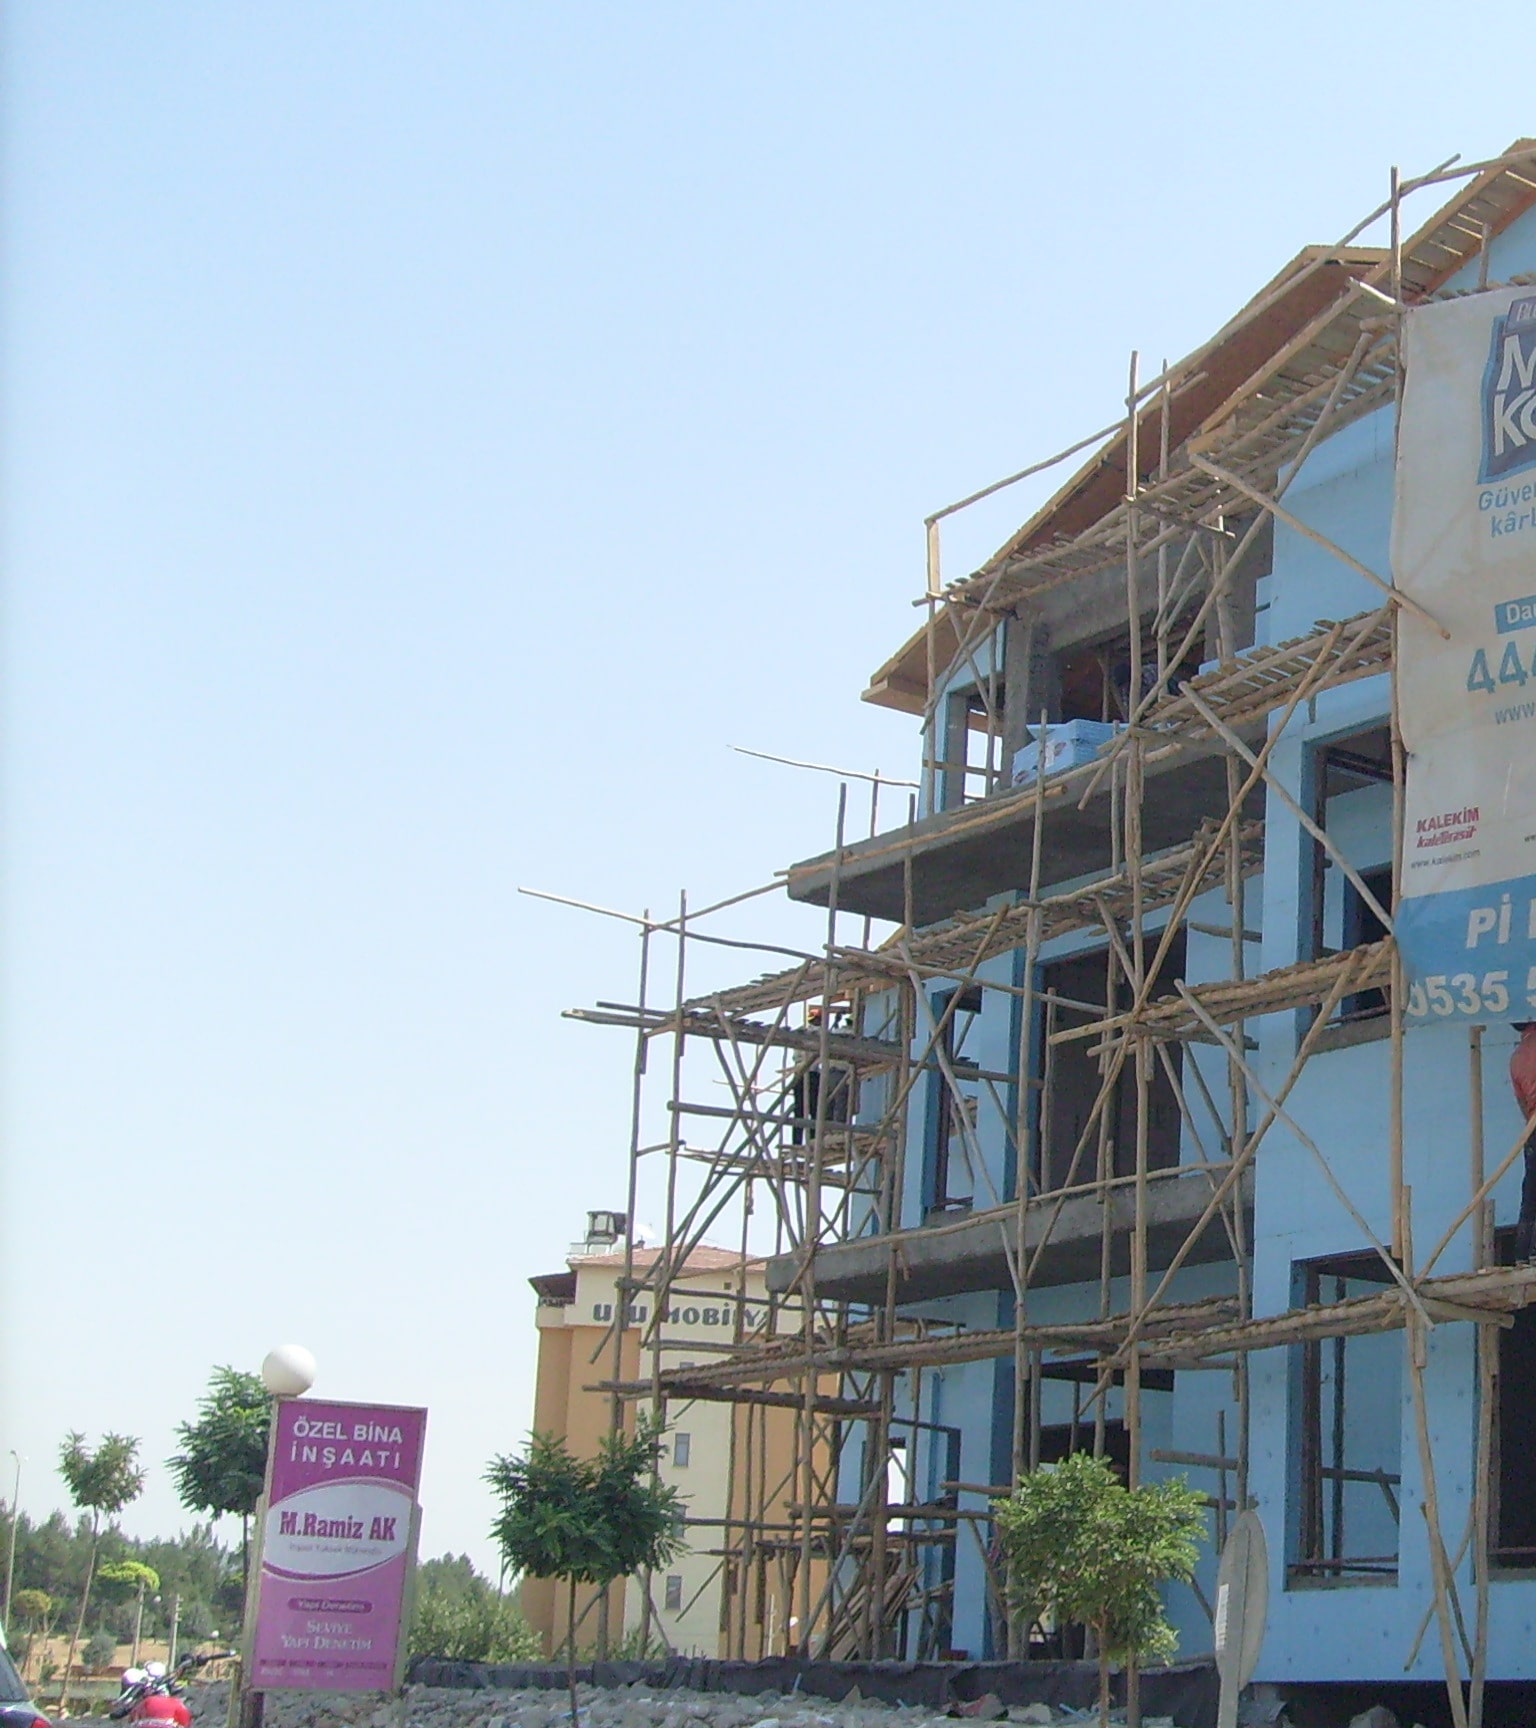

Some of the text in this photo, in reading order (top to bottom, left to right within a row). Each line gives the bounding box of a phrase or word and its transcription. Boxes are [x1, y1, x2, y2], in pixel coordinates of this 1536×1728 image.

[1416, 806, 1480, 833] KALEKİM
[593, 1303, 647, 1324] UU
[293, 1415, 403, 1444] ÖZEL BİNA
[290, 1443, 400, 1470] İNŞAATI
[279, 1510, 397, 1542] M.Ramiz AK
